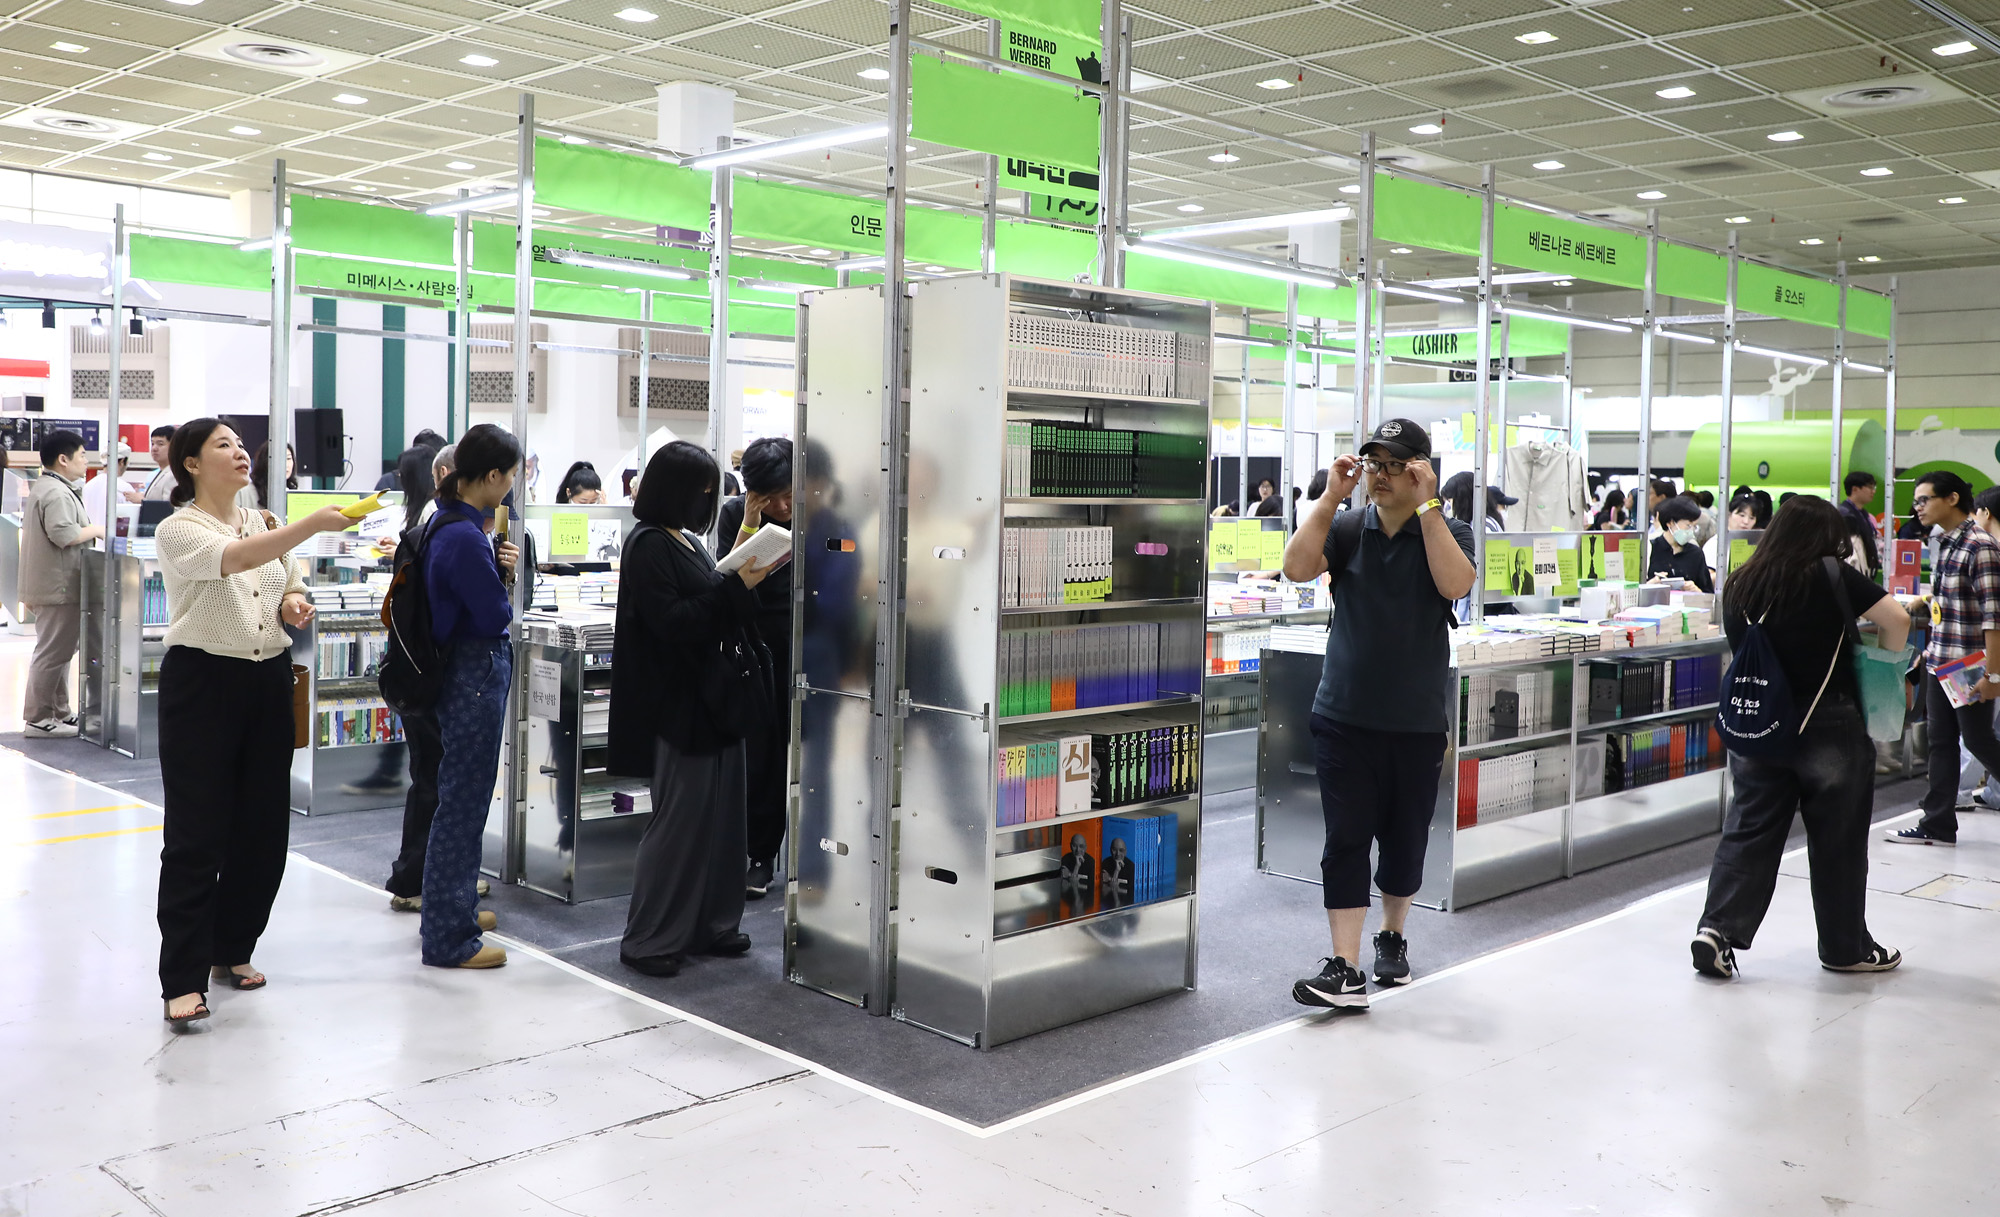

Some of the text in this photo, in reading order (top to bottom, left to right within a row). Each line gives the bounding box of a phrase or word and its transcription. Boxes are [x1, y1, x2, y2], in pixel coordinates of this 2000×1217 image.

[1009, 31, 1057, 54] BERNARD
[1009, 47, 1051, 70] WERBER
[850, 214, 883, 238] 인문
[1529, 231, 1616, 265] 베르나르 베르베르
[1784, 289, 1805, 308] 오스터
[1412, 333, 1458, 356] CASHIER
[1062, 743, 1090, 783] 신
